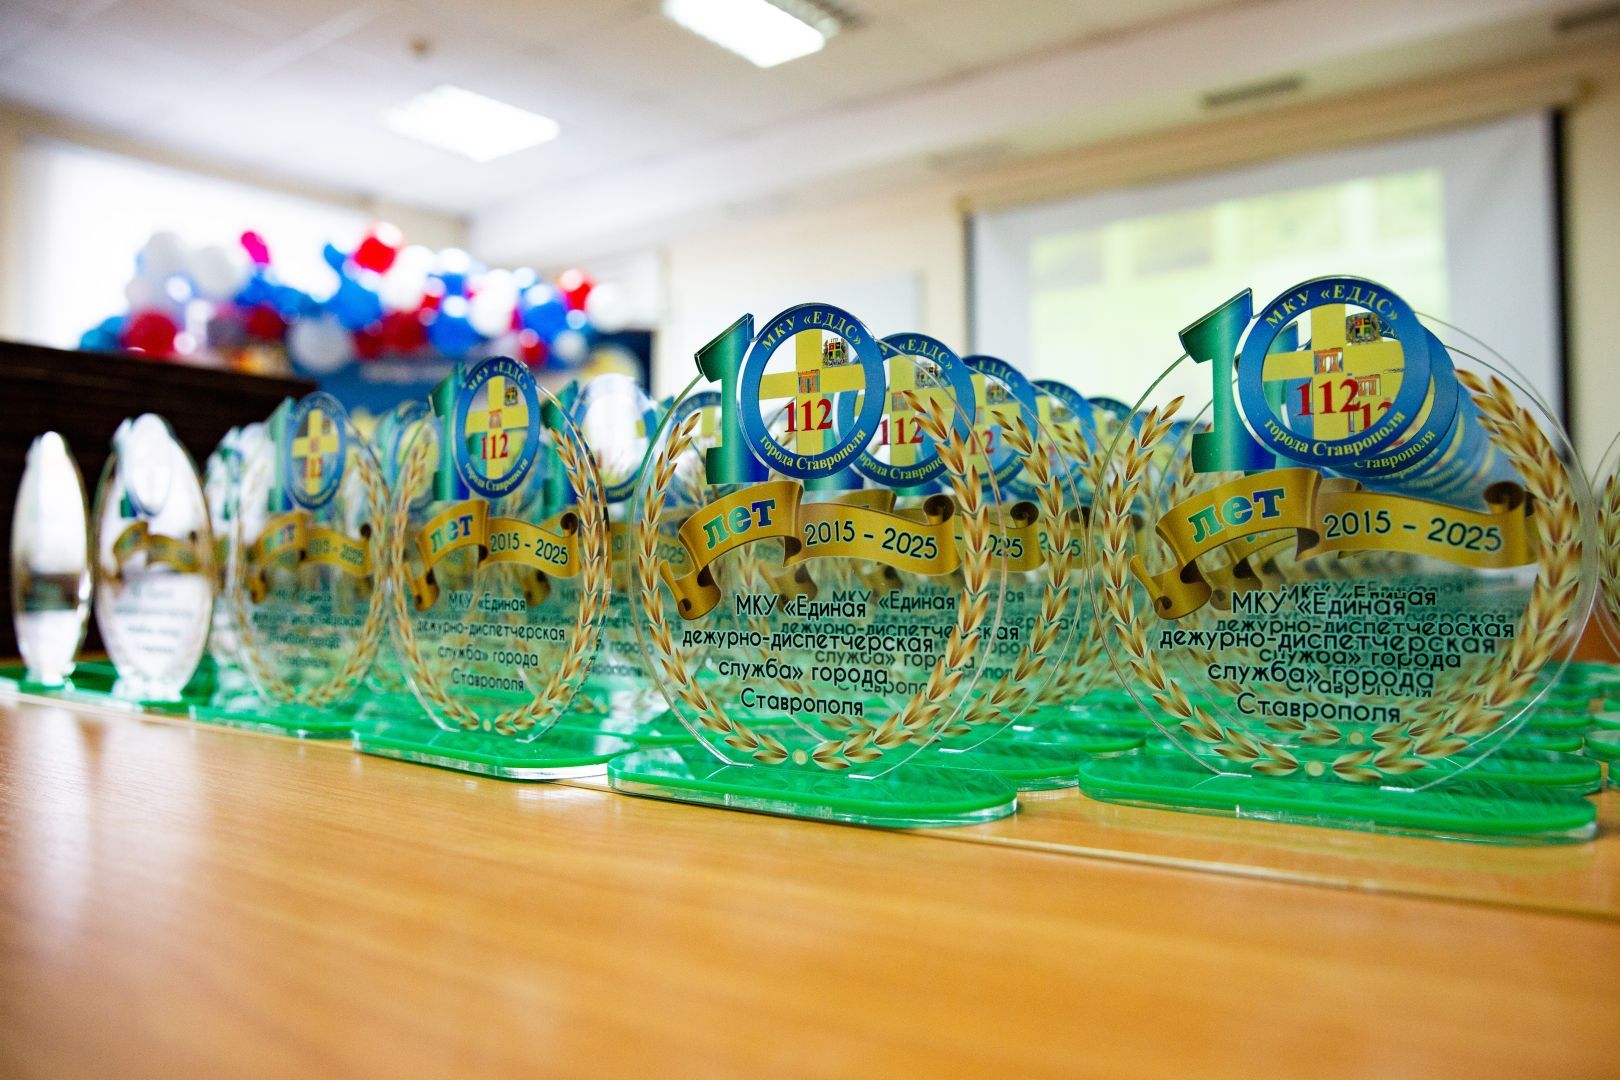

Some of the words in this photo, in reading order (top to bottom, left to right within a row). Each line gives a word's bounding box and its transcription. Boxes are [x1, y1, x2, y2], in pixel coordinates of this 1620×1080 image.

[1266, 289, 1310, 329] МКУ
[1320, 284, 1398, 322] «ЕДДС»
[762, 317, 797, 351] МКУ
[803, 311, 862, 346] «ЕДДС»
[1296, 379, 1360, 416] 112
[784, 398, 833, 432] 112
[880, 417, 924, 446] 112
[1264, 418, 1309, 456] города
[1312, 411, 1407, 457] Ставрополя
[481, 433, 508, 459] 112
[760, 435, 794, 470] города
[796, 429, 867, 471] Ставрополя
[860, 452, 888, 477] орода
[889, 457, 944, 479] Ставропо
[703, 499, 776, 549] лет
[804, 520, 855, 547] 2015
[882, 528, 938, 560] 2025
[1188, 487, 1285, 543] лет
[1324, 510, 1392, 538] 2015
[1427, 518, 1502, 552] 2025
[430, 515, 474, 553] лет
[490, 533, 520, 552] 2015
[535, 538, 568, 565] 2025
[736, 594, 778, 617] МКУ
[784, 596, 866, 620] «Единая
[878, 590, 956, 612] «Единая
[1232, 591, 1286, 614] МКУ
[1297, 592, 1406, 619] «Единая
[416, 619, 566, 642] дежурно-диспетчерская
[683, 628, 933, 656] дежурно-диспетчерская
[781, 621, 1019, 642] дежурно-диспетческая
[1160, 628, 1496, 655] дежурно-диспетчерская
[493, 651, 539, 669] города
[719, 659, 803, 684] служба»
[811, 664, 889, 687] города
[903, 653, 975, 672] гороа
[451, 668, 525, 692] Ставрополя
[1208, 660, 1321, 685] служба»
[1332, 668, 1434, 691] города
[741, 688, 864, 717] Ставрополя
[1237, 692, 1400, 724] Ставрополя
